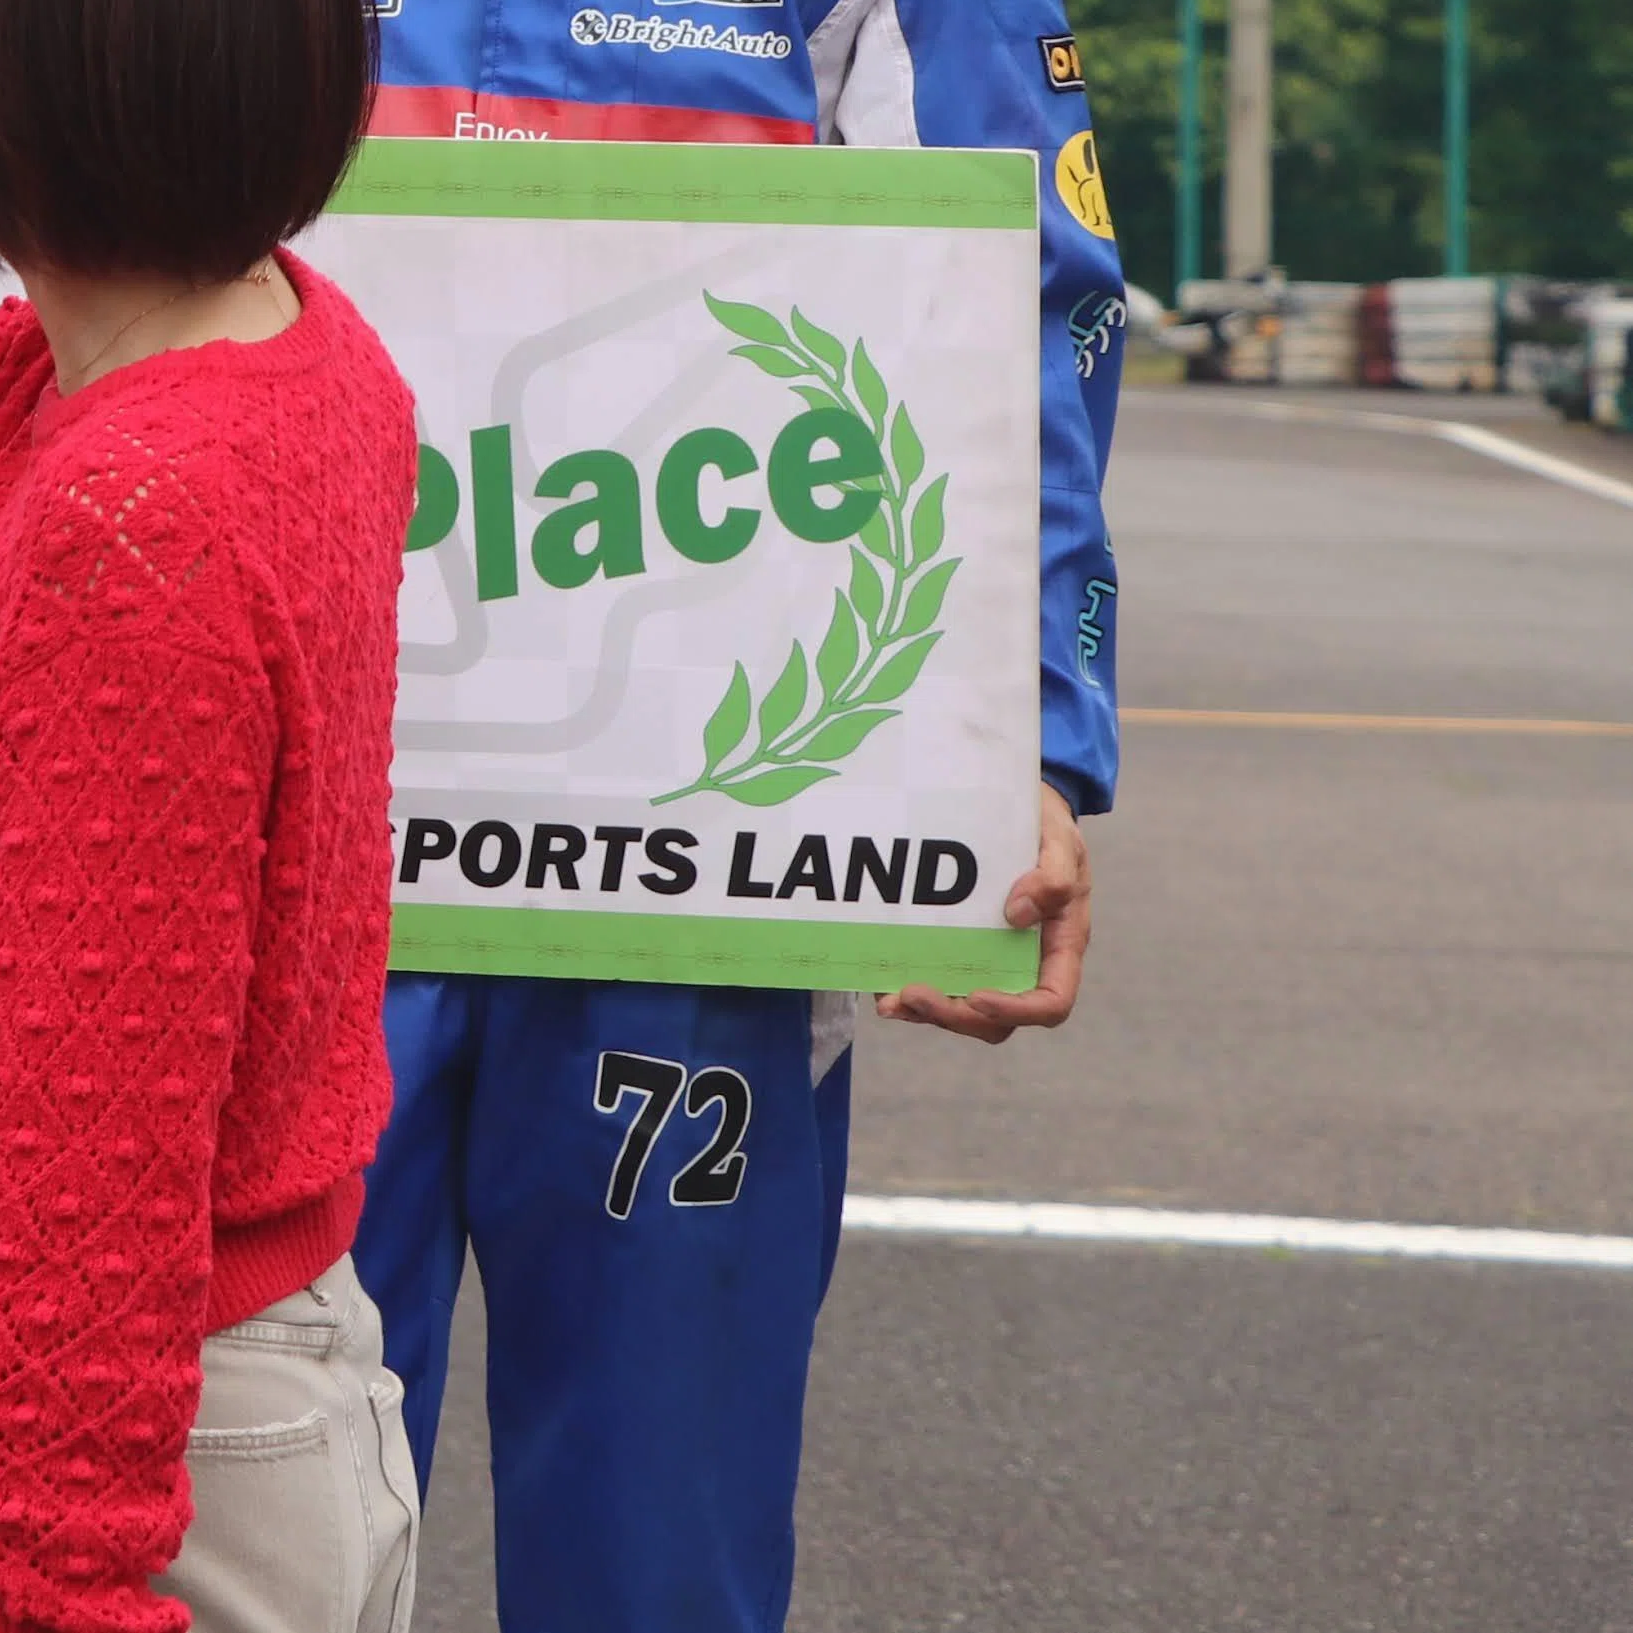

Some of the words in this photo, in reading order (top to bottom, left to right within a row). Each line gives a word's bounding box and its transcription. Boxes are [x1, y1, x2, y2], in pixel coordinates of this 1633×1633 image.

[390, 819, 701, 898] PORTS
[725, 831, 980, 908] LAND
[592, 1050, 753, 1221] 72
